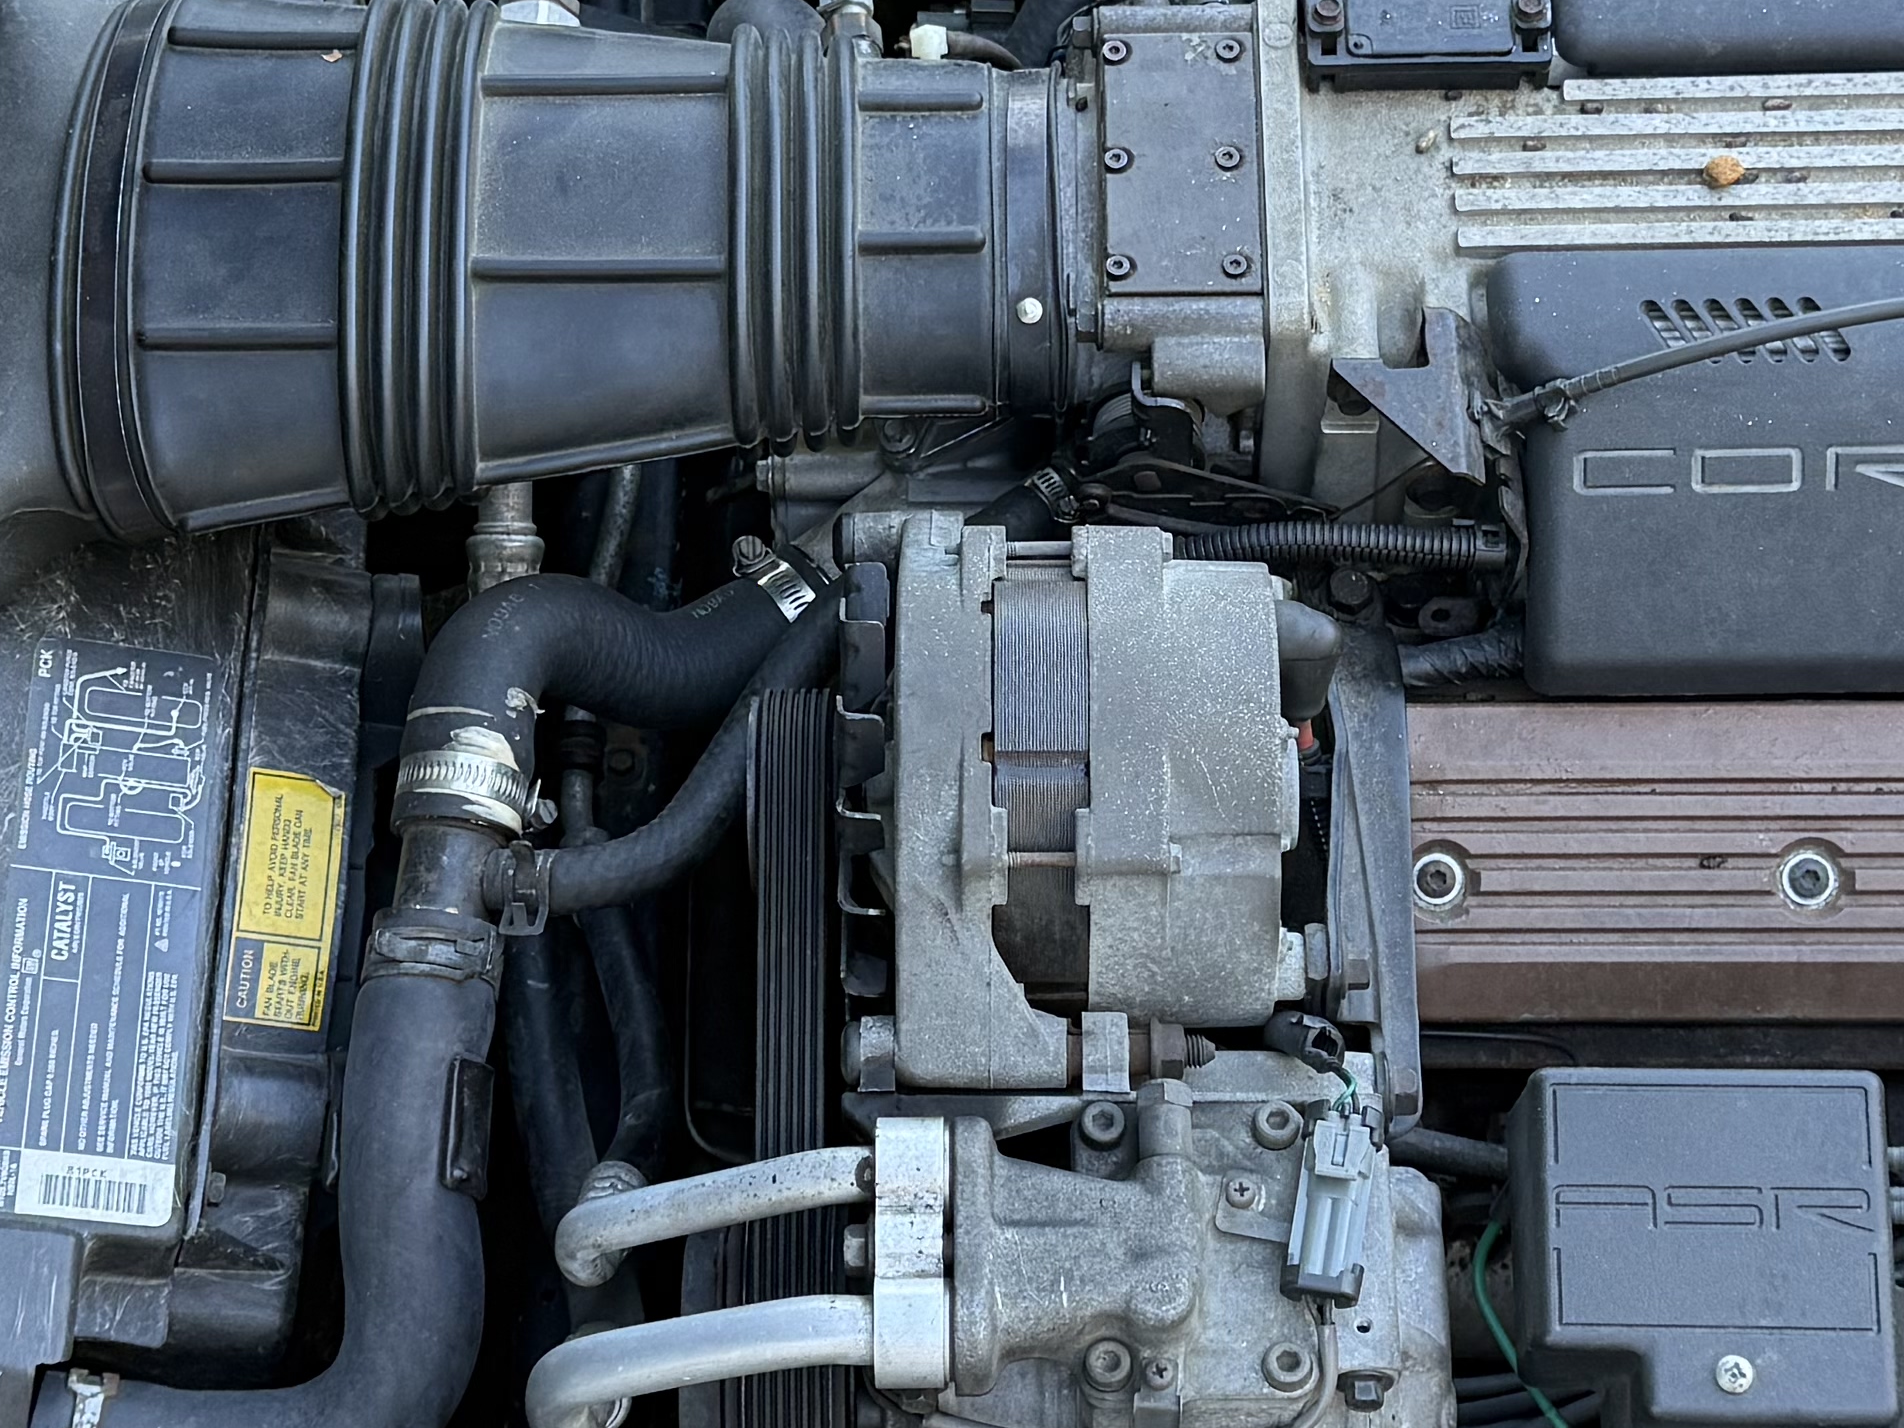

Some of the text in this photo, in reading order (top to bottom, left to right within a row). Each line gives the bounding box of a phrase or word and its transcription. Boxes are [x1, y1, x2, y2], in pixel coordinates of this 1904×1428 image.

[38, 647, 54, 678] PCK
[290, 829, 301, 861] BLADE
[287, 861, 298, 882] FAN
[299, 851, 310, 872] ANY
[264, 874, 275, 900] HELP
[298, 873, 308, 887] AT
[262, 901, 272, 915] TO
[294, 888, 306, 920] START
[9, 897, 28, 969] INFORMATION
[50, 880, 76, 961] CATALYST
[235, 947, 254, 1008] CAUTION
[262, 960, 277, 1016] FAN BLADE
[3, 971, 20, 1022] CONTROL
[1553, 1183, 1876, 1233] ASR
